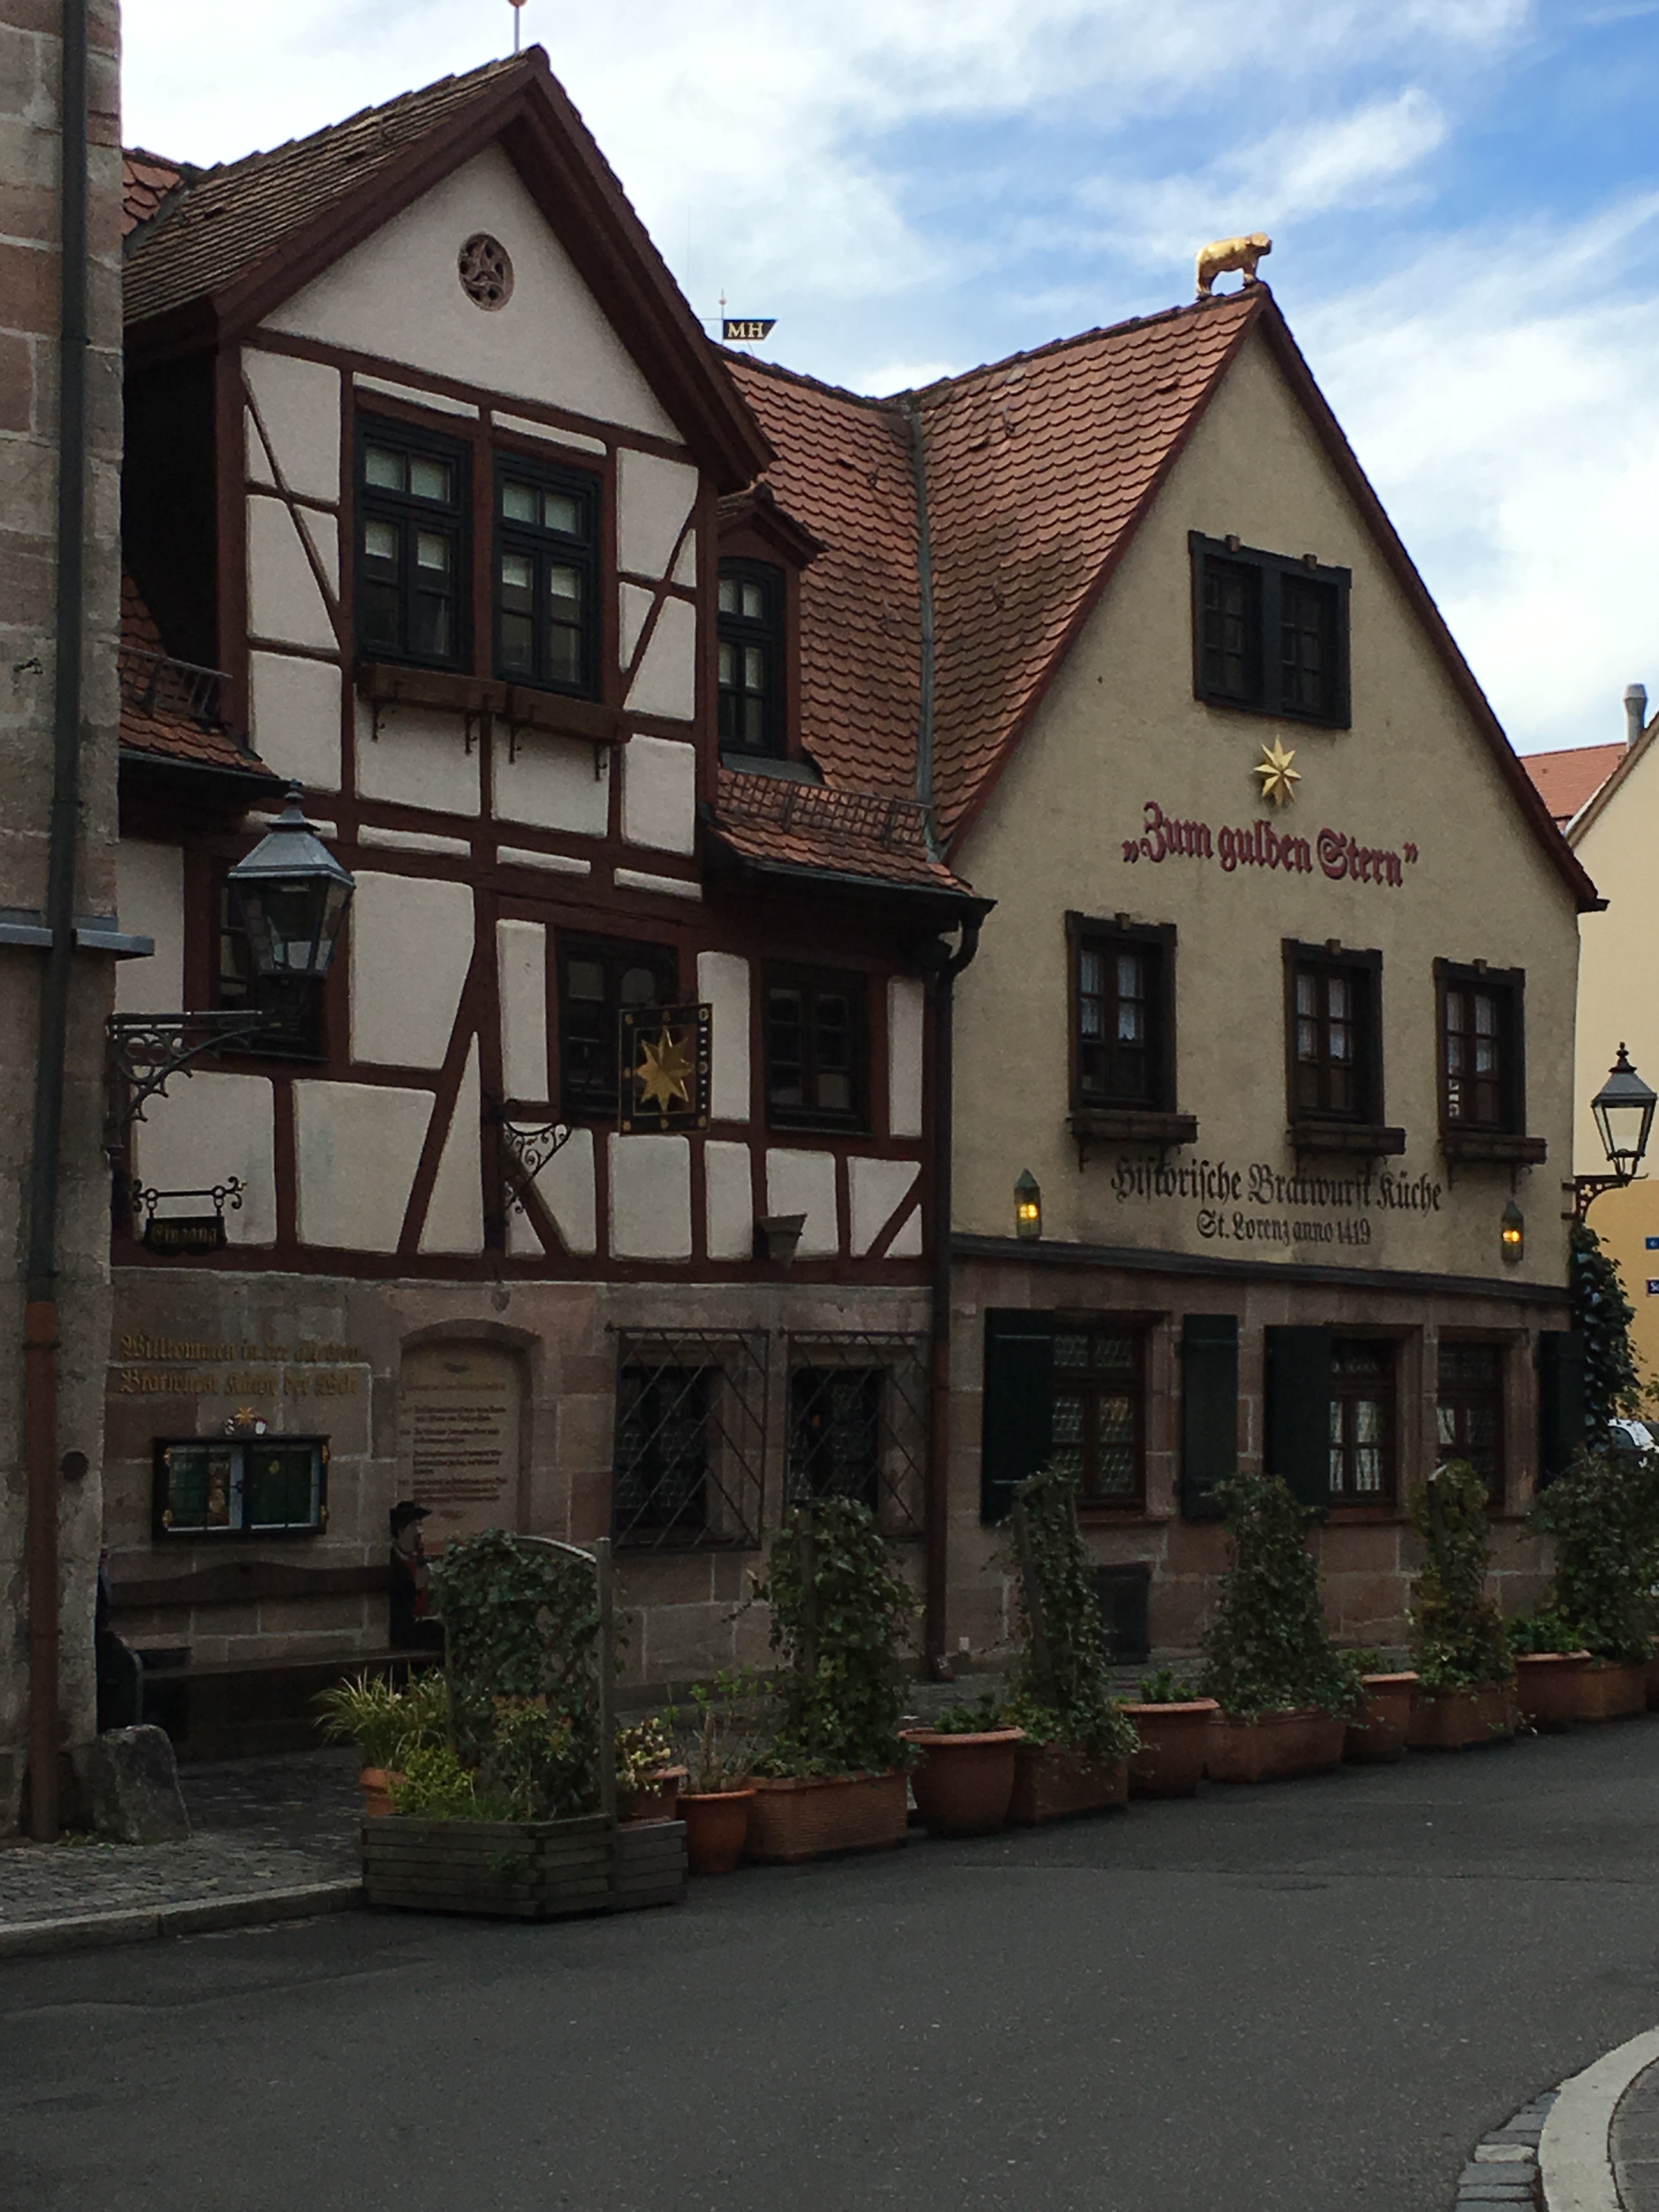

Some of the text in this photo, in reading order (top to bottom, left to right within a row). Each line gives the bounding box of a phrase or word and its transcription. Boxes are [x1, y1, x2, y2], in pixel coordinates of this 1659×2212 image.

[727, 322, 764, 337] MH
[1218, 819, 1313, 872] gulden
[1376, 1171, 1441, 1217] Küche
[1197, 1209, 1371, 1246] St. Lorenz anno 1419
